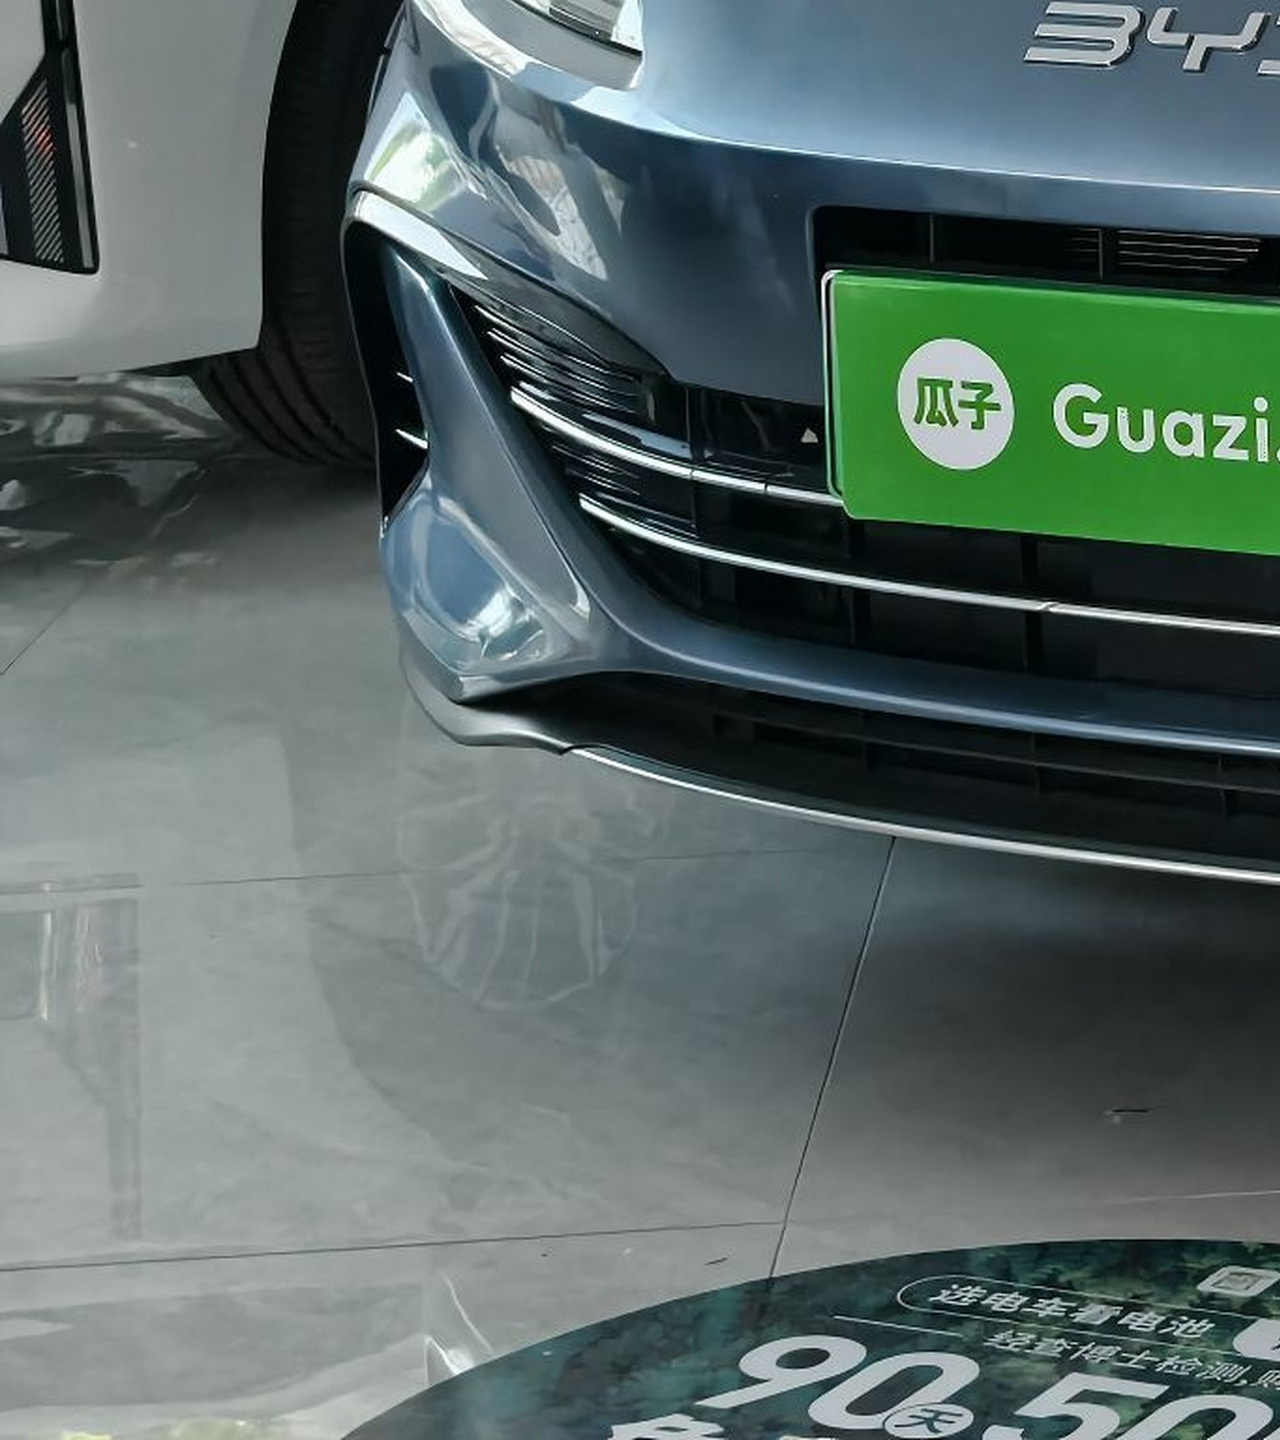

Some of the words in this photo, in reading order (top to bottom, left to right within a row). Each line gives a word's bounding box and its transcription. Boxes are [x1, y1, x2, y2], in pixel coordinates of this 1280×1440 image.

[913, 376, 1002, 432] 瓜子
[929, 1283, 1215, 1338] 选电车看电池
